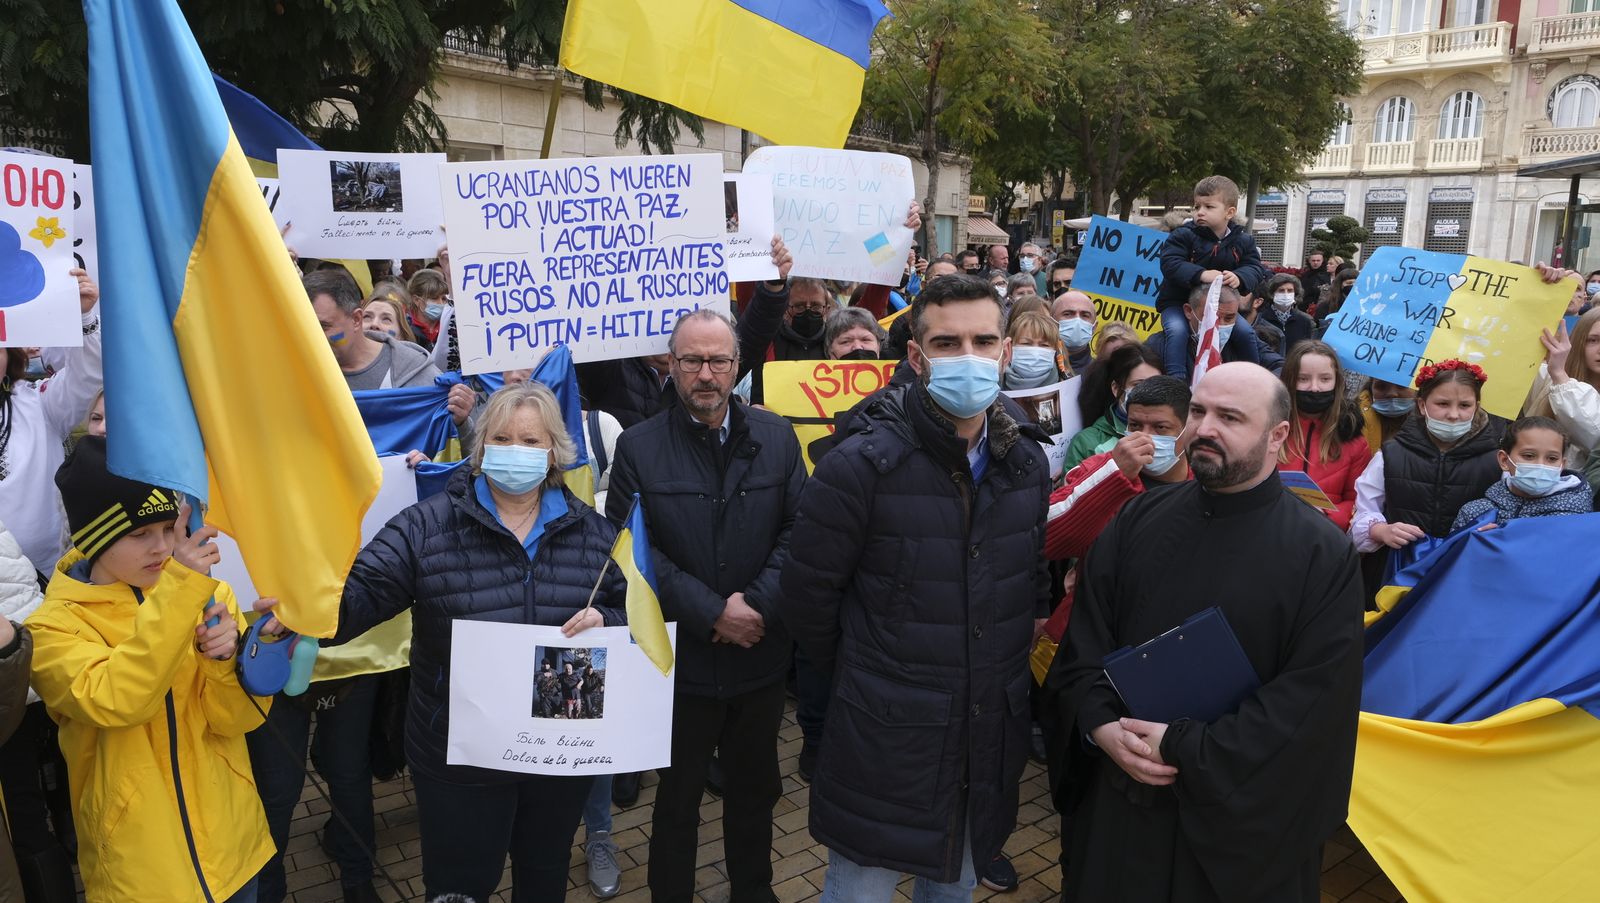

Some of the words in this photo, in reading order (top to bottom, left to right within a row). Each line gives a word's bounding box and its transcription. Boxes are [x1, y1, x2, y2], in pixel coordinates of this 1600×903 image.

[456, 165, 600, 200] UCRANIANOS
[610, 164, 691, 191] MUEREN
[771, 173, 848, 193] EREMOS
[857, 179, 882, 193] UN
[481, 201, 531, 230] POR
[537, 196, 629, 225] VUESTRA
[773, 196, 839, 224] UNDO
[857, 203, 895, 227] EN
[783, 227, 847, 255] PAZ
[1091, 225, 1123, 252] NO
[1136, 235, 1163, 262] WA
[462, 259, 536, 291] FUERA
[543, 242, 724, 282] REPRESENTANTES
[1099, 267, 1125, 288] IN
[1133, 274, 1165, 297] MY
[1391, 256, 1448, 289] STOP
[1469, 268, 1518, 299] THE
[567, 280, 601, 310] NO
[605, 277, 635, 305] AL
[637, 270, 729, 301] RUSCISMO
[1088, 296, 1161, 332] OUNTRY
[1403, 300, 1456, 329] WAR
[1410, 329, 1427, 345] IS
[1354, 343, 1386, 365] ON
[1396, 352, 1435, 378] FI
[137, 503, 175, 517] adidas
[515, 731, 547, 746] Біль
[556, 734, 596, 748] війни
[543, 753, 554, 765] de
[555, 753, 568, 765] la
